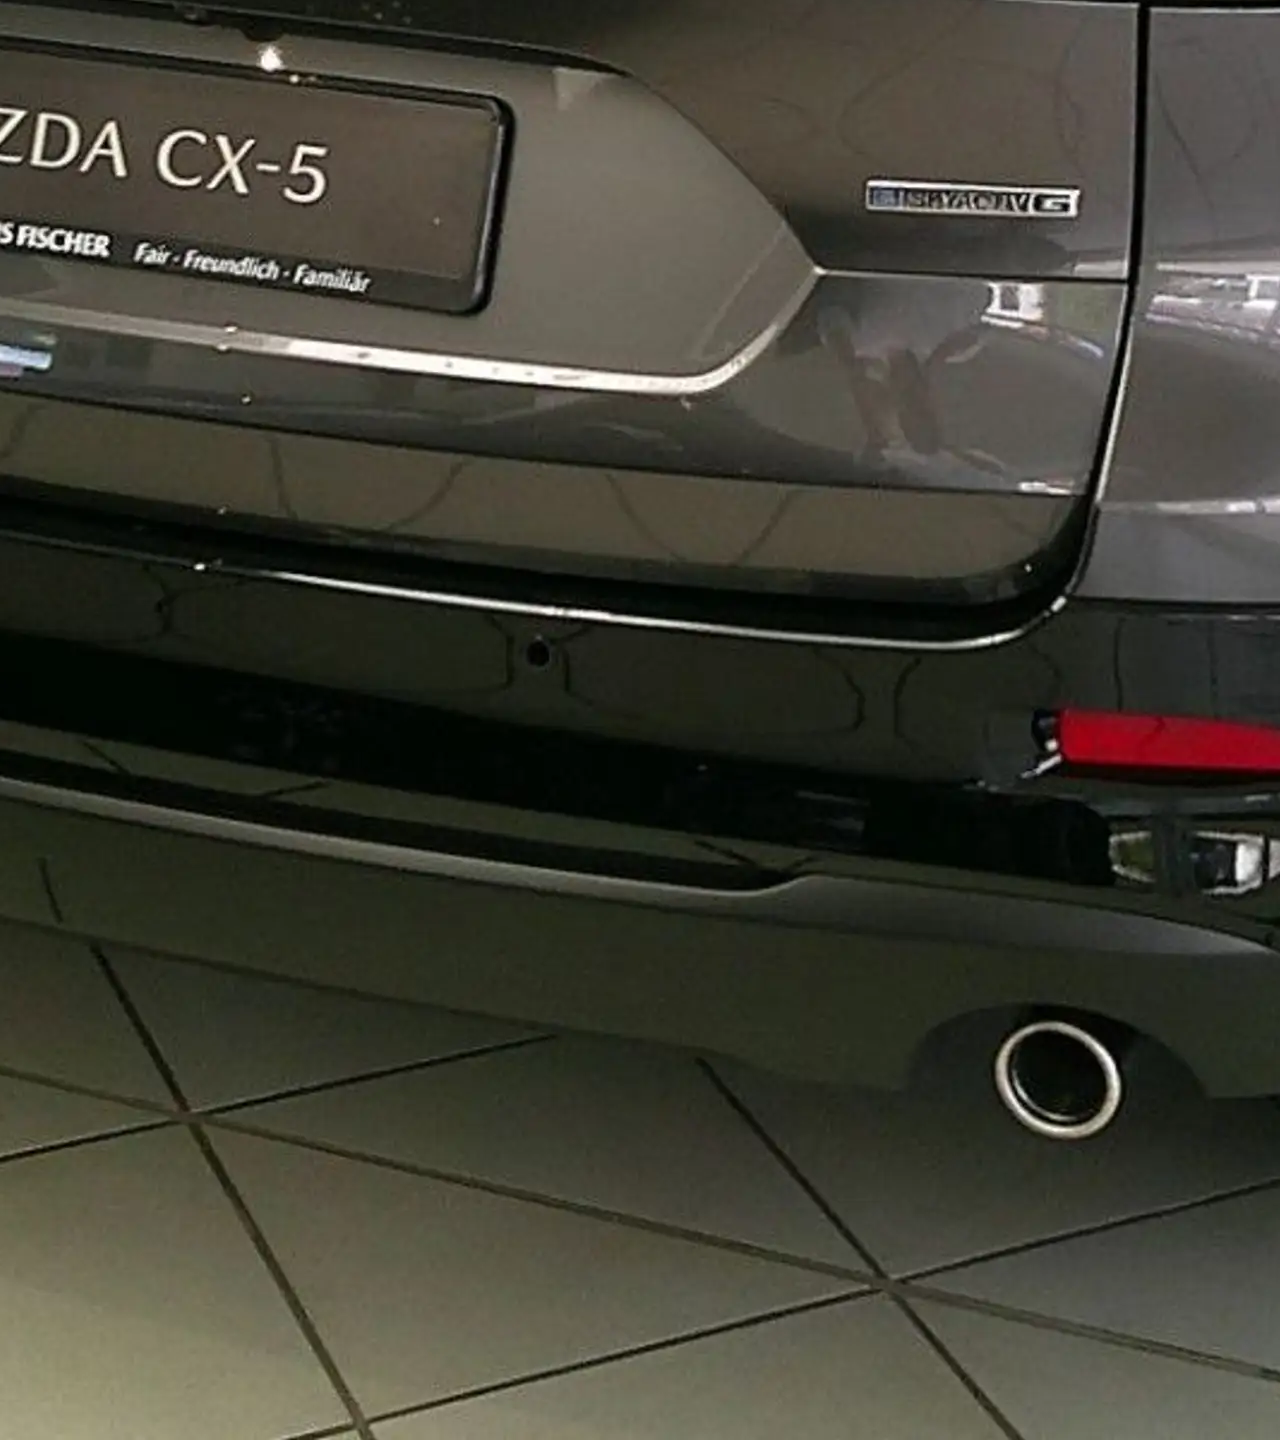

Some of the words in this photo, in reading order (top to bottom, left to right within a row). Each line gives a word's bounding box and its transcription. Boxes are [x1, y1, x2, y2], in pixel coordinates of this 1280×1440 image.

[156, 129, 329, 204] CX-5
[16, 224, 111, 258] FISCHER
[133, 242, 172, 266] Fair
[183, 249, 280, 282] Freundlich
[292, 264, 372, 293] Familiär
